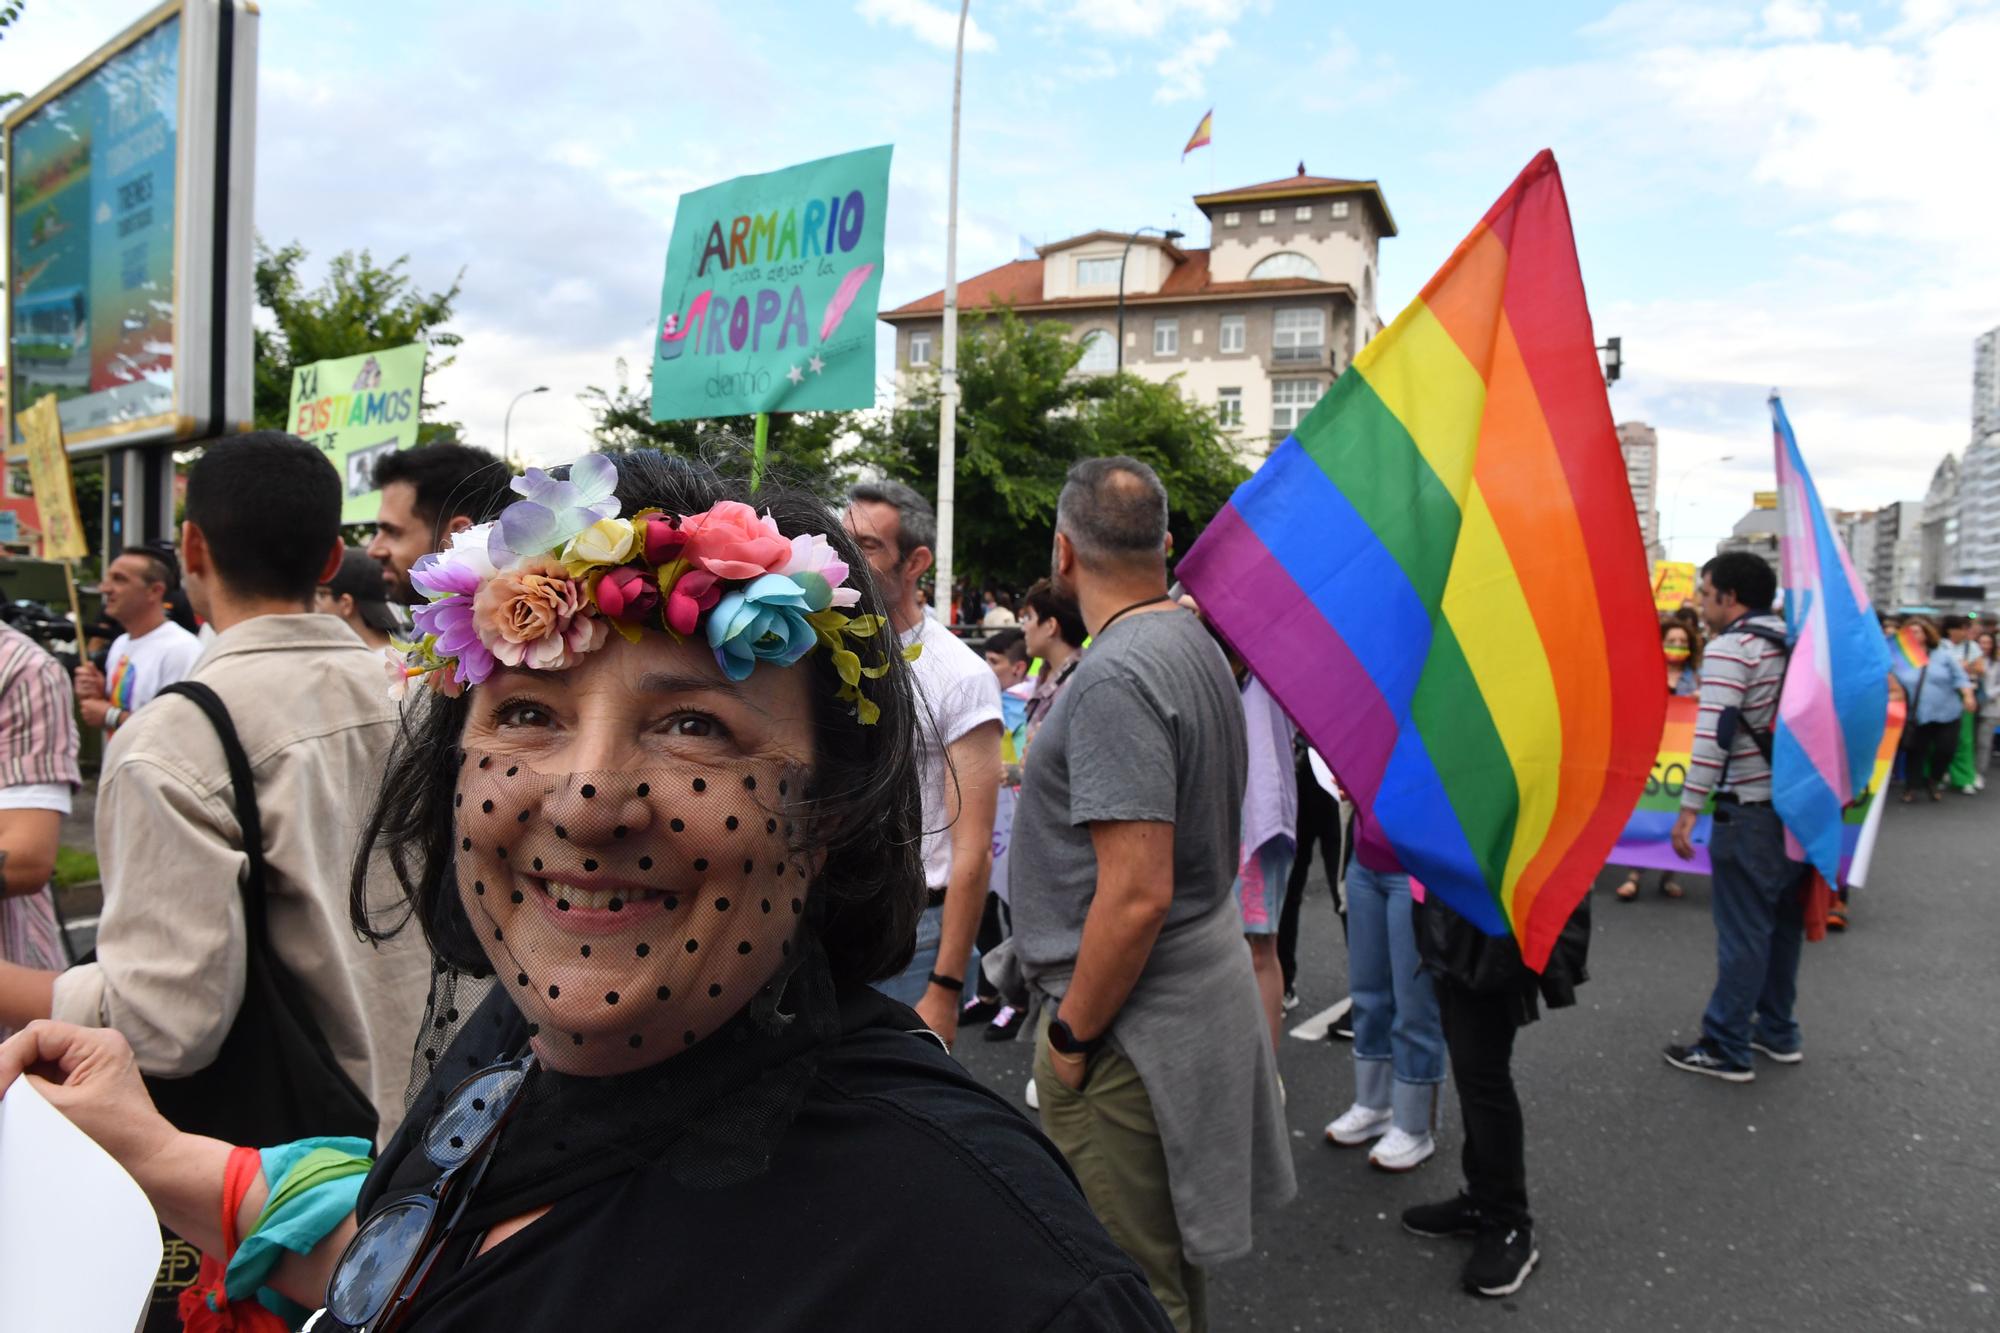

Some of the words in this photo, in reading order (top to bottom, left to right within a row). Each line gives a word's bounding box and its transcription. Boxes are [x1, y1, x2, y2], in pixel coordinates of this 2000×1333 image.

[697, 190, 865, 278] ARMARIO
[817, 257, 836, 277] la
[706, 284, 809, 355] ROPA
[297, 366, 318, 402] XA
[705, 355, 772, 399] dentro
